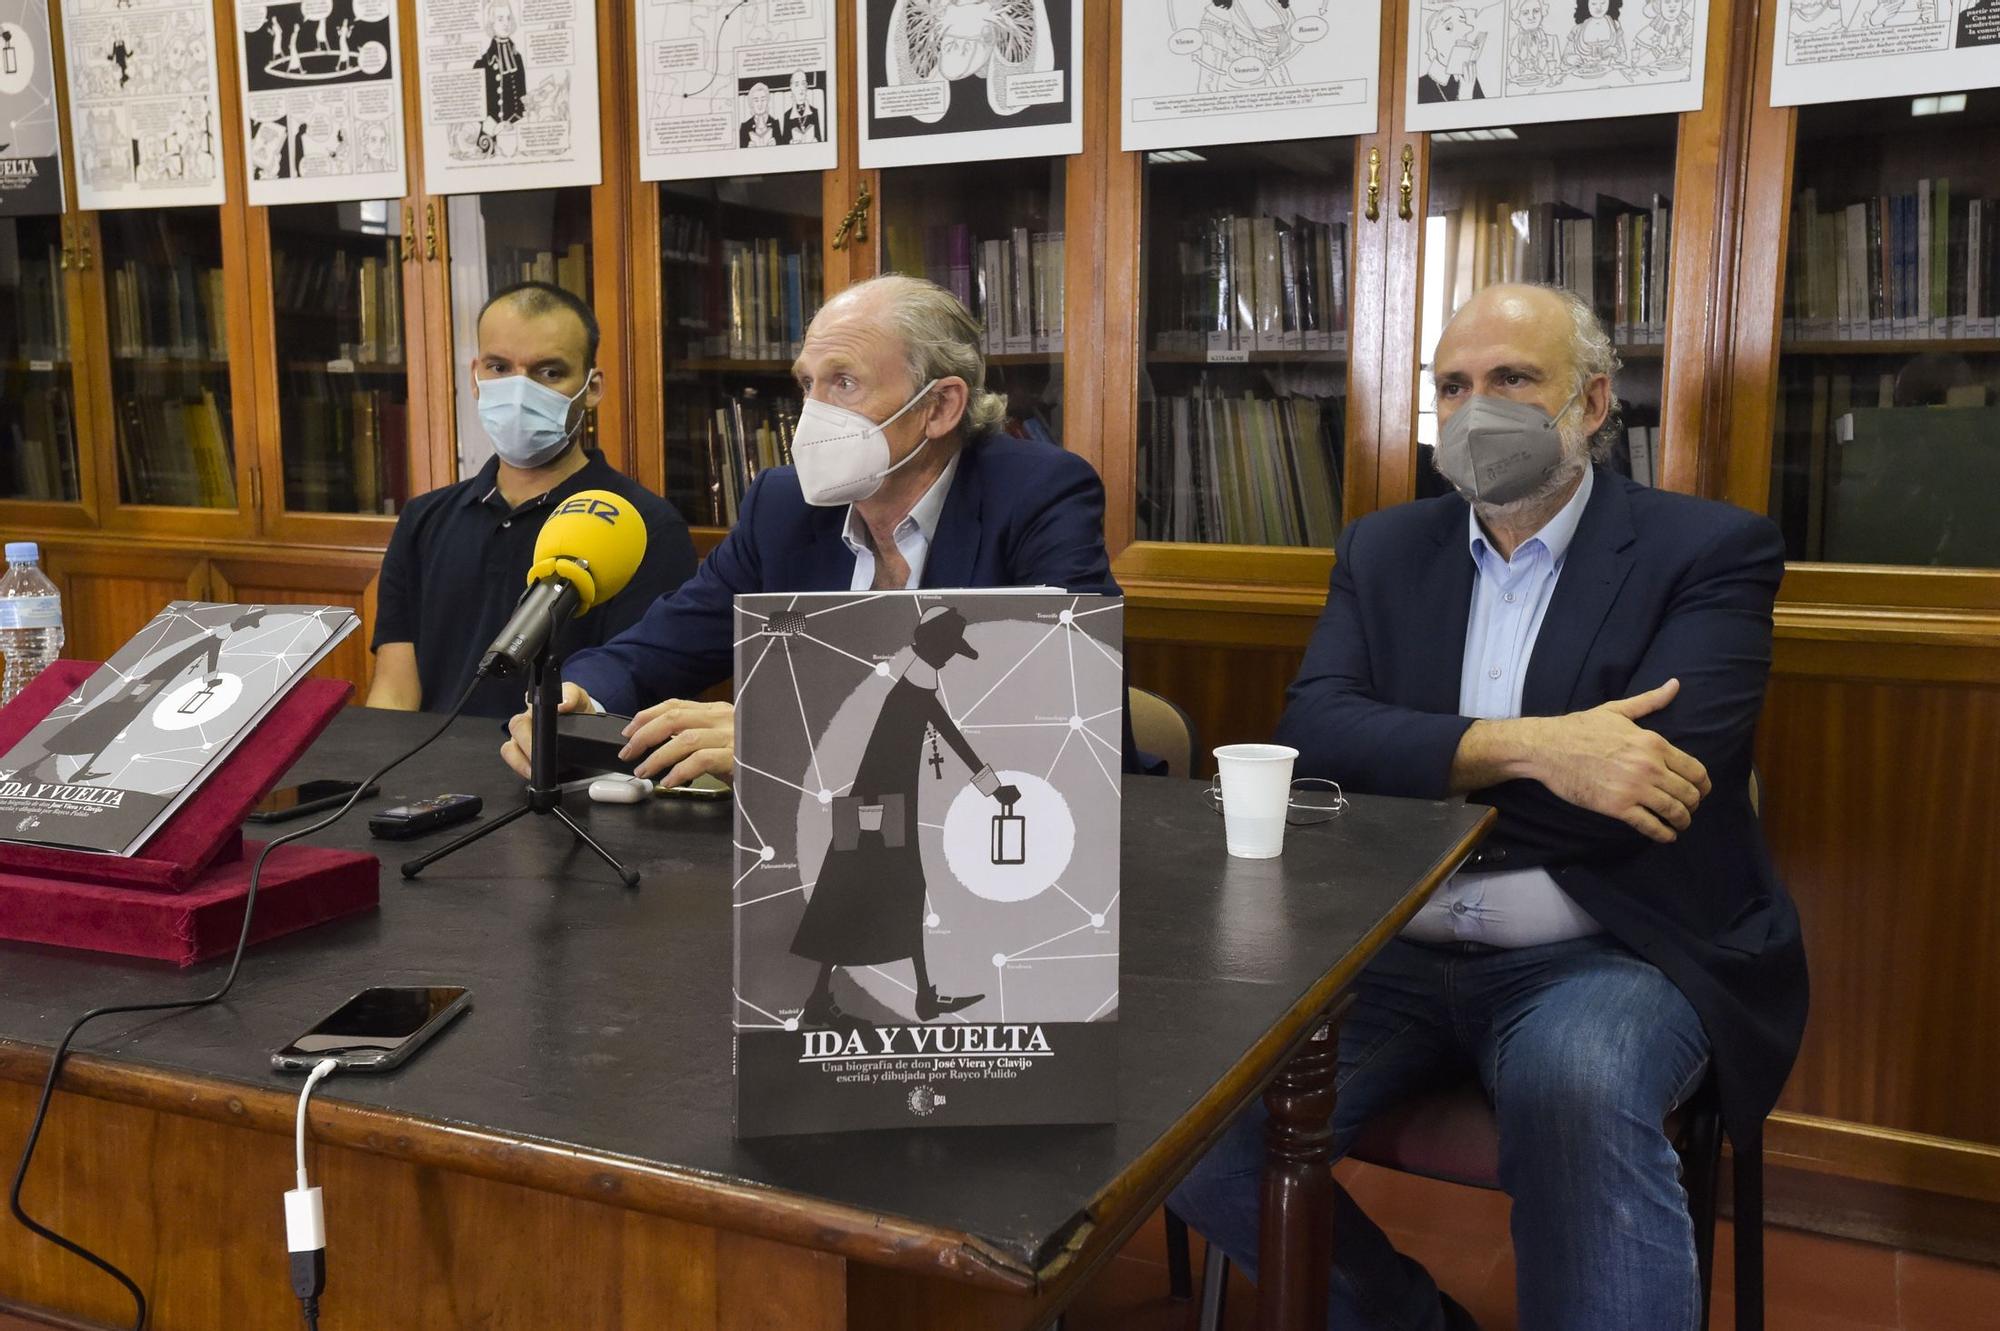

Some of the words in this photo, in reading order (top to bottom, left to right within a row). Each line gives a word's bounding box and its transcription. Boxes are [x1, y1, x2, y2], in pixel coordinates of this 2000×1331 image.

[32, 783, 53, 798] Y
[50, 784, 125, 806] VUELTA
[778, 1007, 799, 1015] Madrid
[801, 1029, 869, 1058] IDA
[874, 1028, 901, 1054] Y
[906, 1025, 1052, 1054] VUELTA
[821, 1062, 843, 1072] Una
[846, 1059, 893, 1073] biografía
[895, 1059, 908, 1070] de
[910, 1059, 931, 1069] don
[932, 1057, 956, 1071] José
[958, 1057, 986, 1068] Viera
[988, 1060, 996, 1071] y
[996, 1057, 1033, 1070] Clavijo
[836, 1071, 870, 1083] escrita
[872, 1073, 879, 1084] y
[881, 1070, 926, 1084] dibujada
[928, 1071, 948, 1083] por
[949, 1070, 981, 1082] Rayco
[983, 1069, 1017, 1080] Pulido
